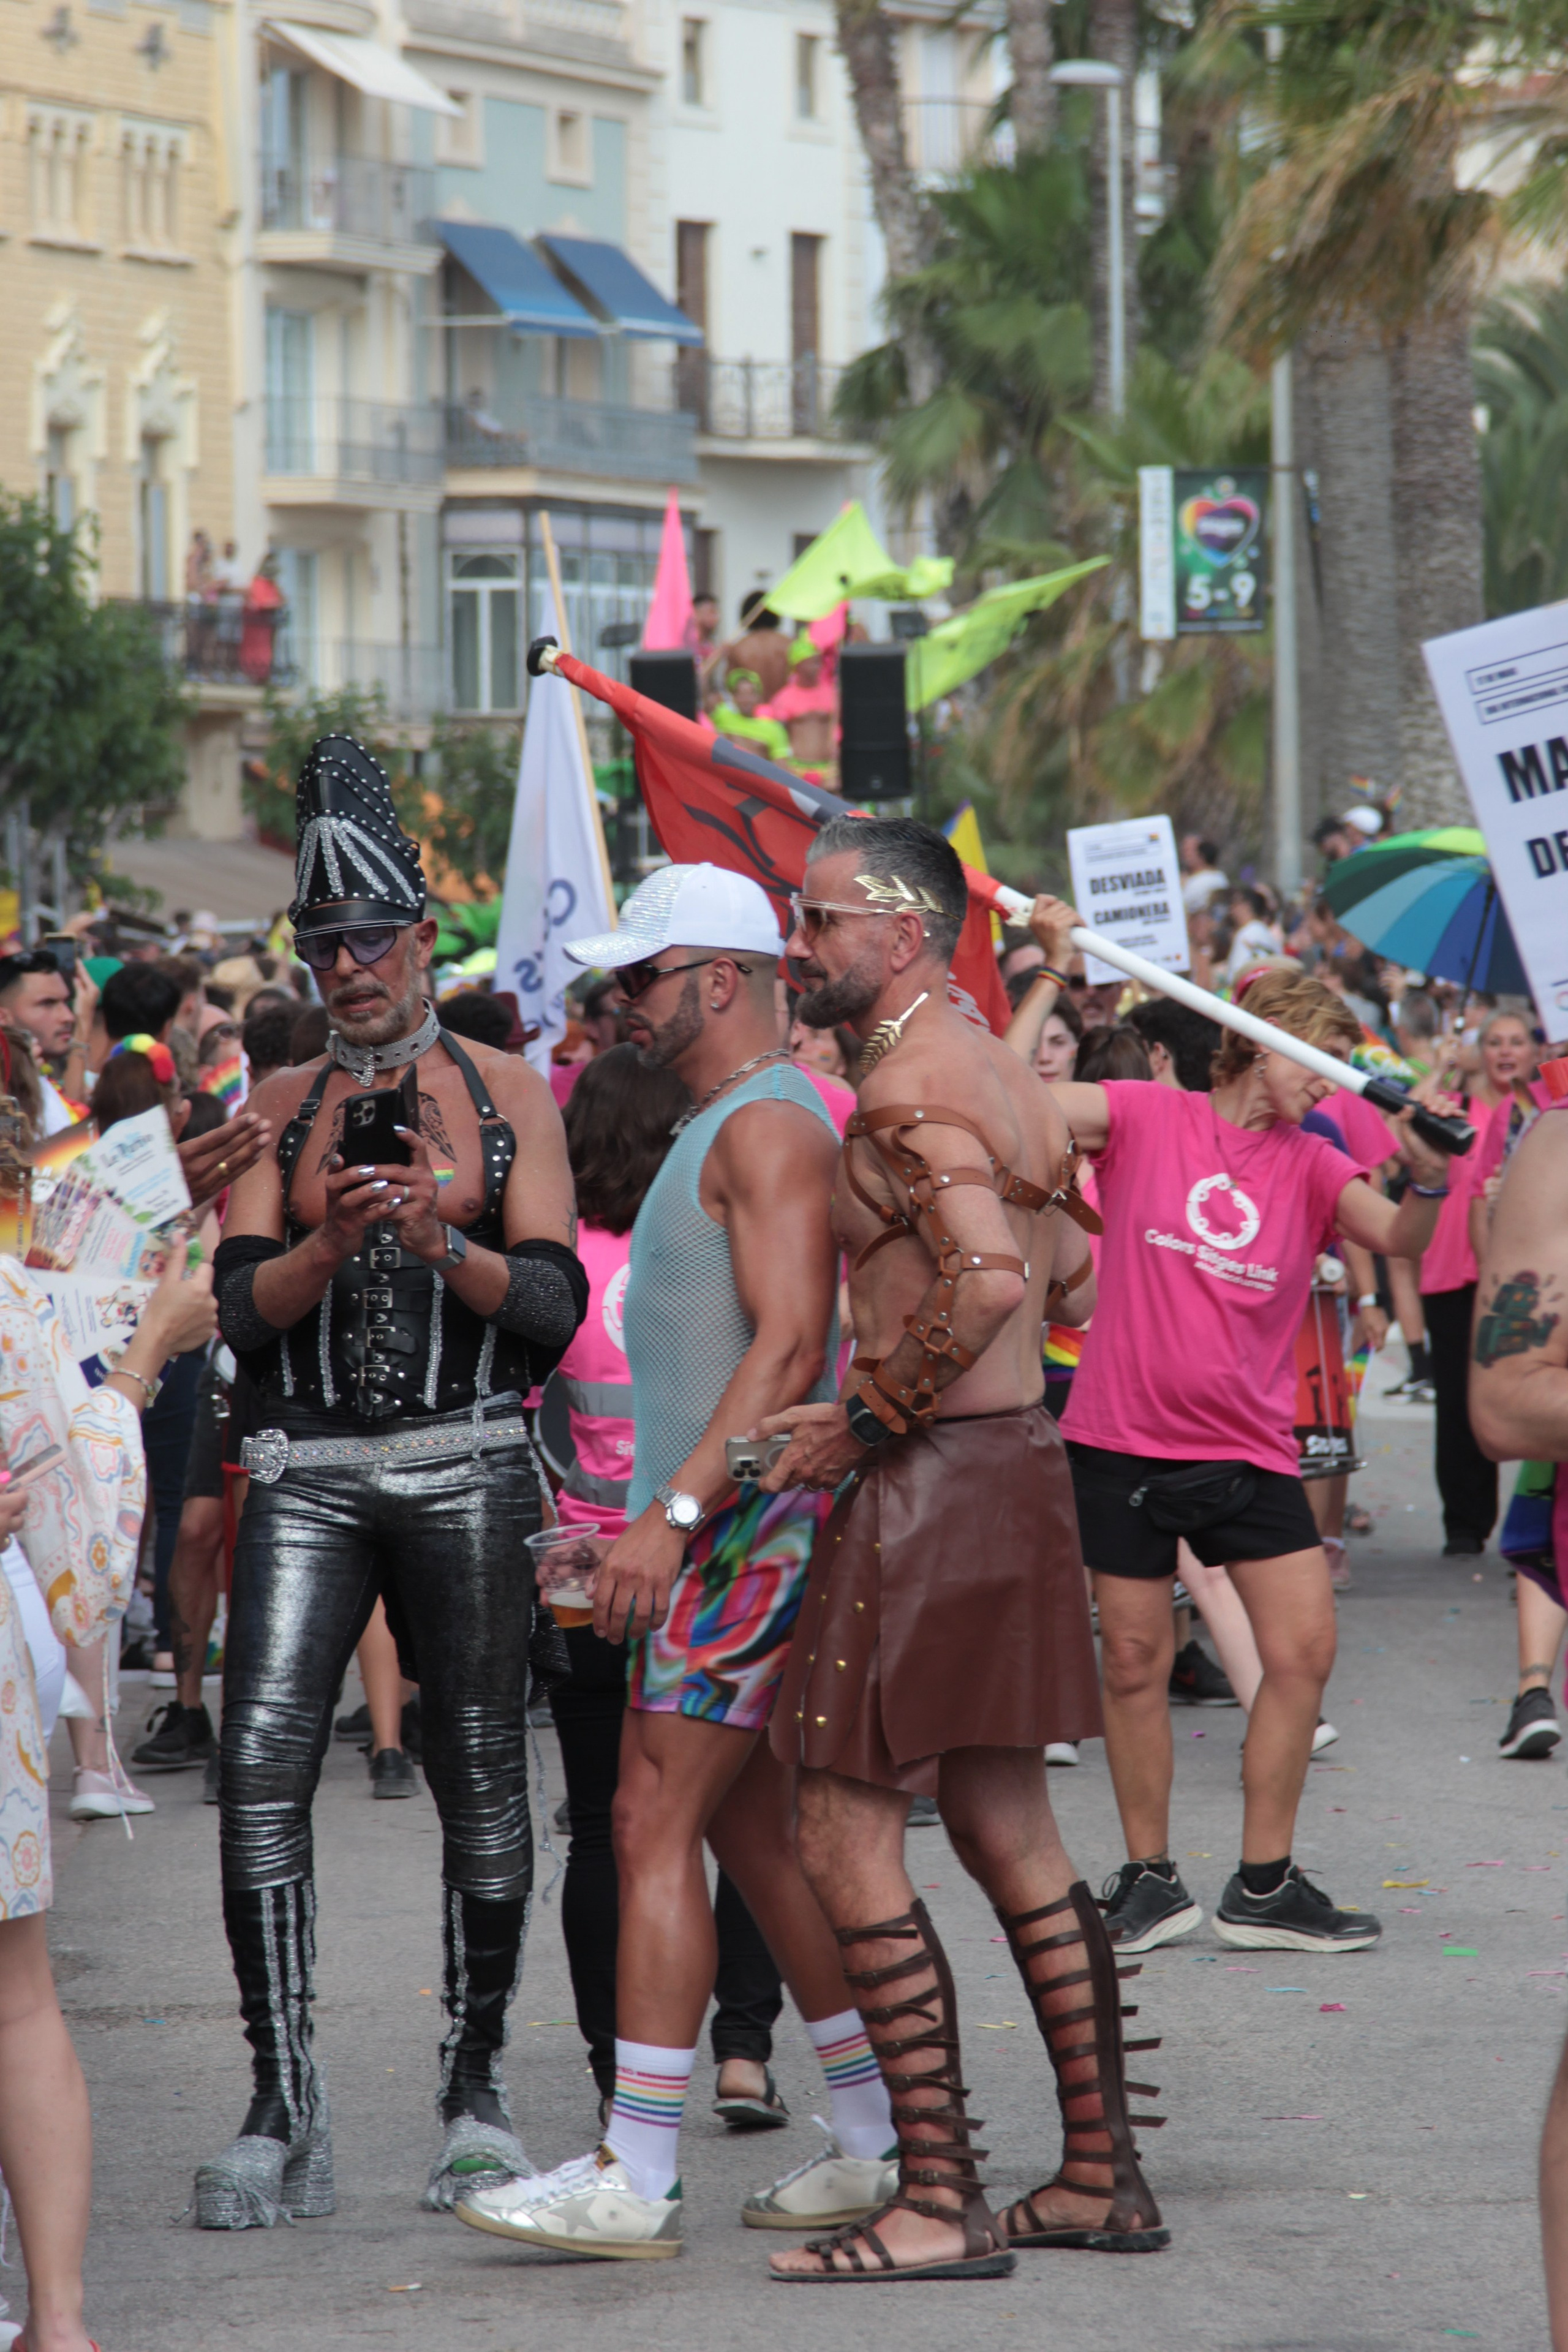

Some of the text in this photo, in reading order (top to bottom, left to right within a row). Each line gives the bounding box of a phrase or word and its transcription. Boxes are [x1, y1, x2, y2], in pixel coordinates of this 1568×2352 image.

[1185, 571, 1256, 610] 5-9
[1089, 867, 1166, 895] DESVIADA
[1094, 902, 1171, 926] CAMIONERA
[1144, 1229, 1196, 1255] Colors
[1246, 1263, 1280, 1283] Link
